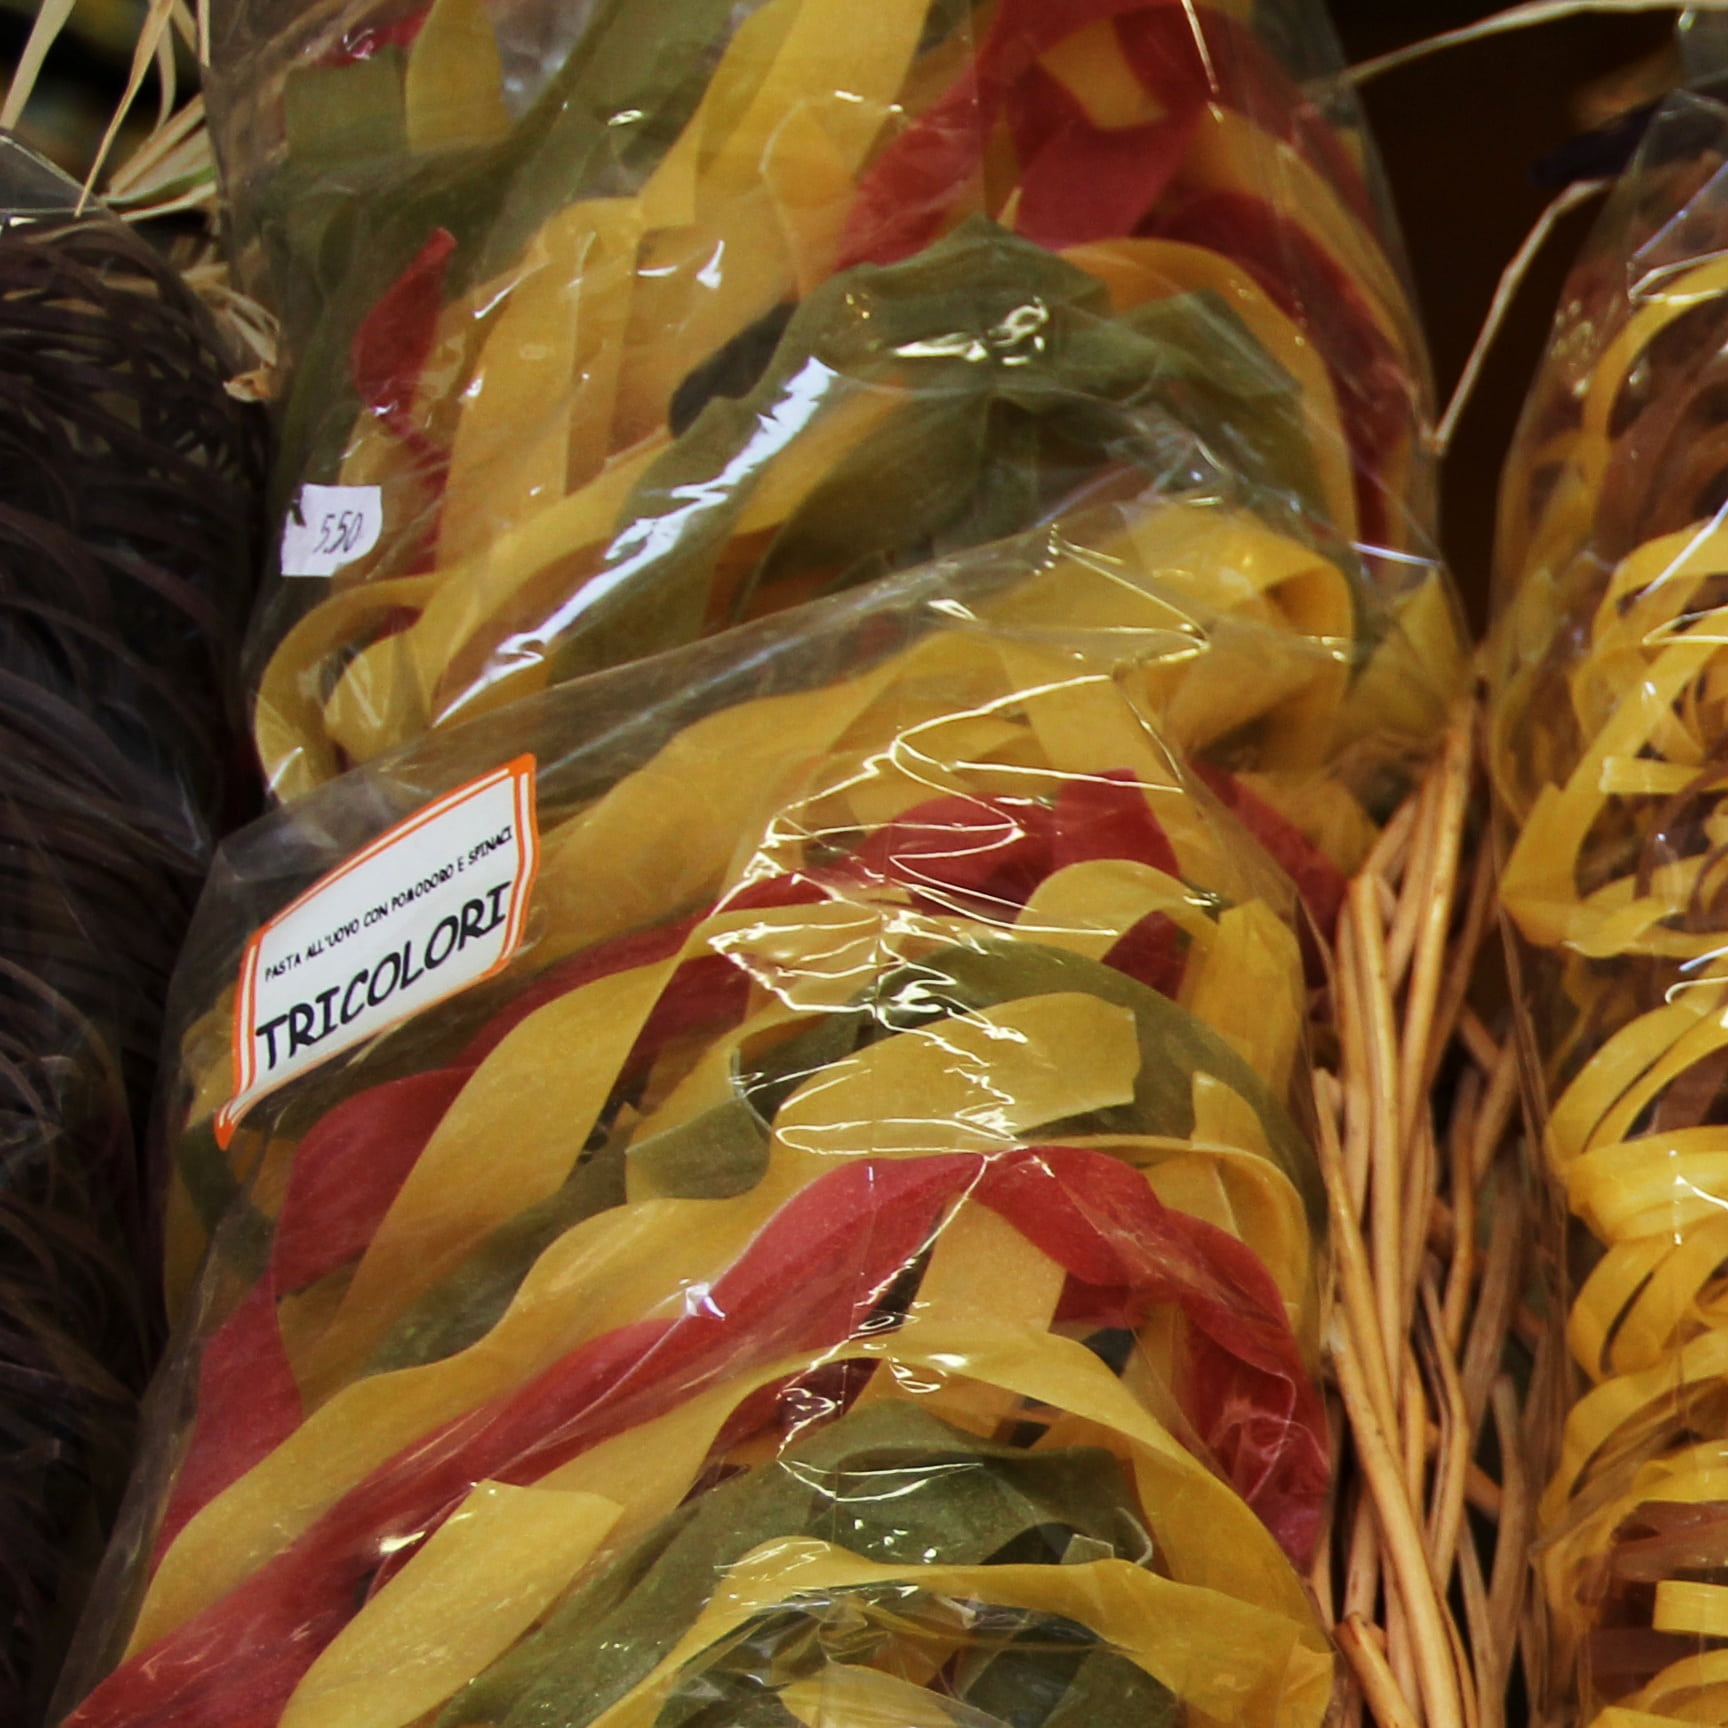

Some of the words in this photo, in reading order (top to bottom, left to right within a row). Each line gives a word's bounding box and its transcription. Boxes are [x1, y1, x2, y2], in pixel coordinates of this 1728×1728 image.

[256, 880, 512, 1070] TRICOLORI
[264, 953, 302, 982] PASTA
[305, 918, 360, 959] ALL'UOVO
[363, 902, 388, 927] CON
[390, 863, 454, 912] POMODORO
[457, 858, 464, 873] E
[467, 825, 513, 865] SPINACI
